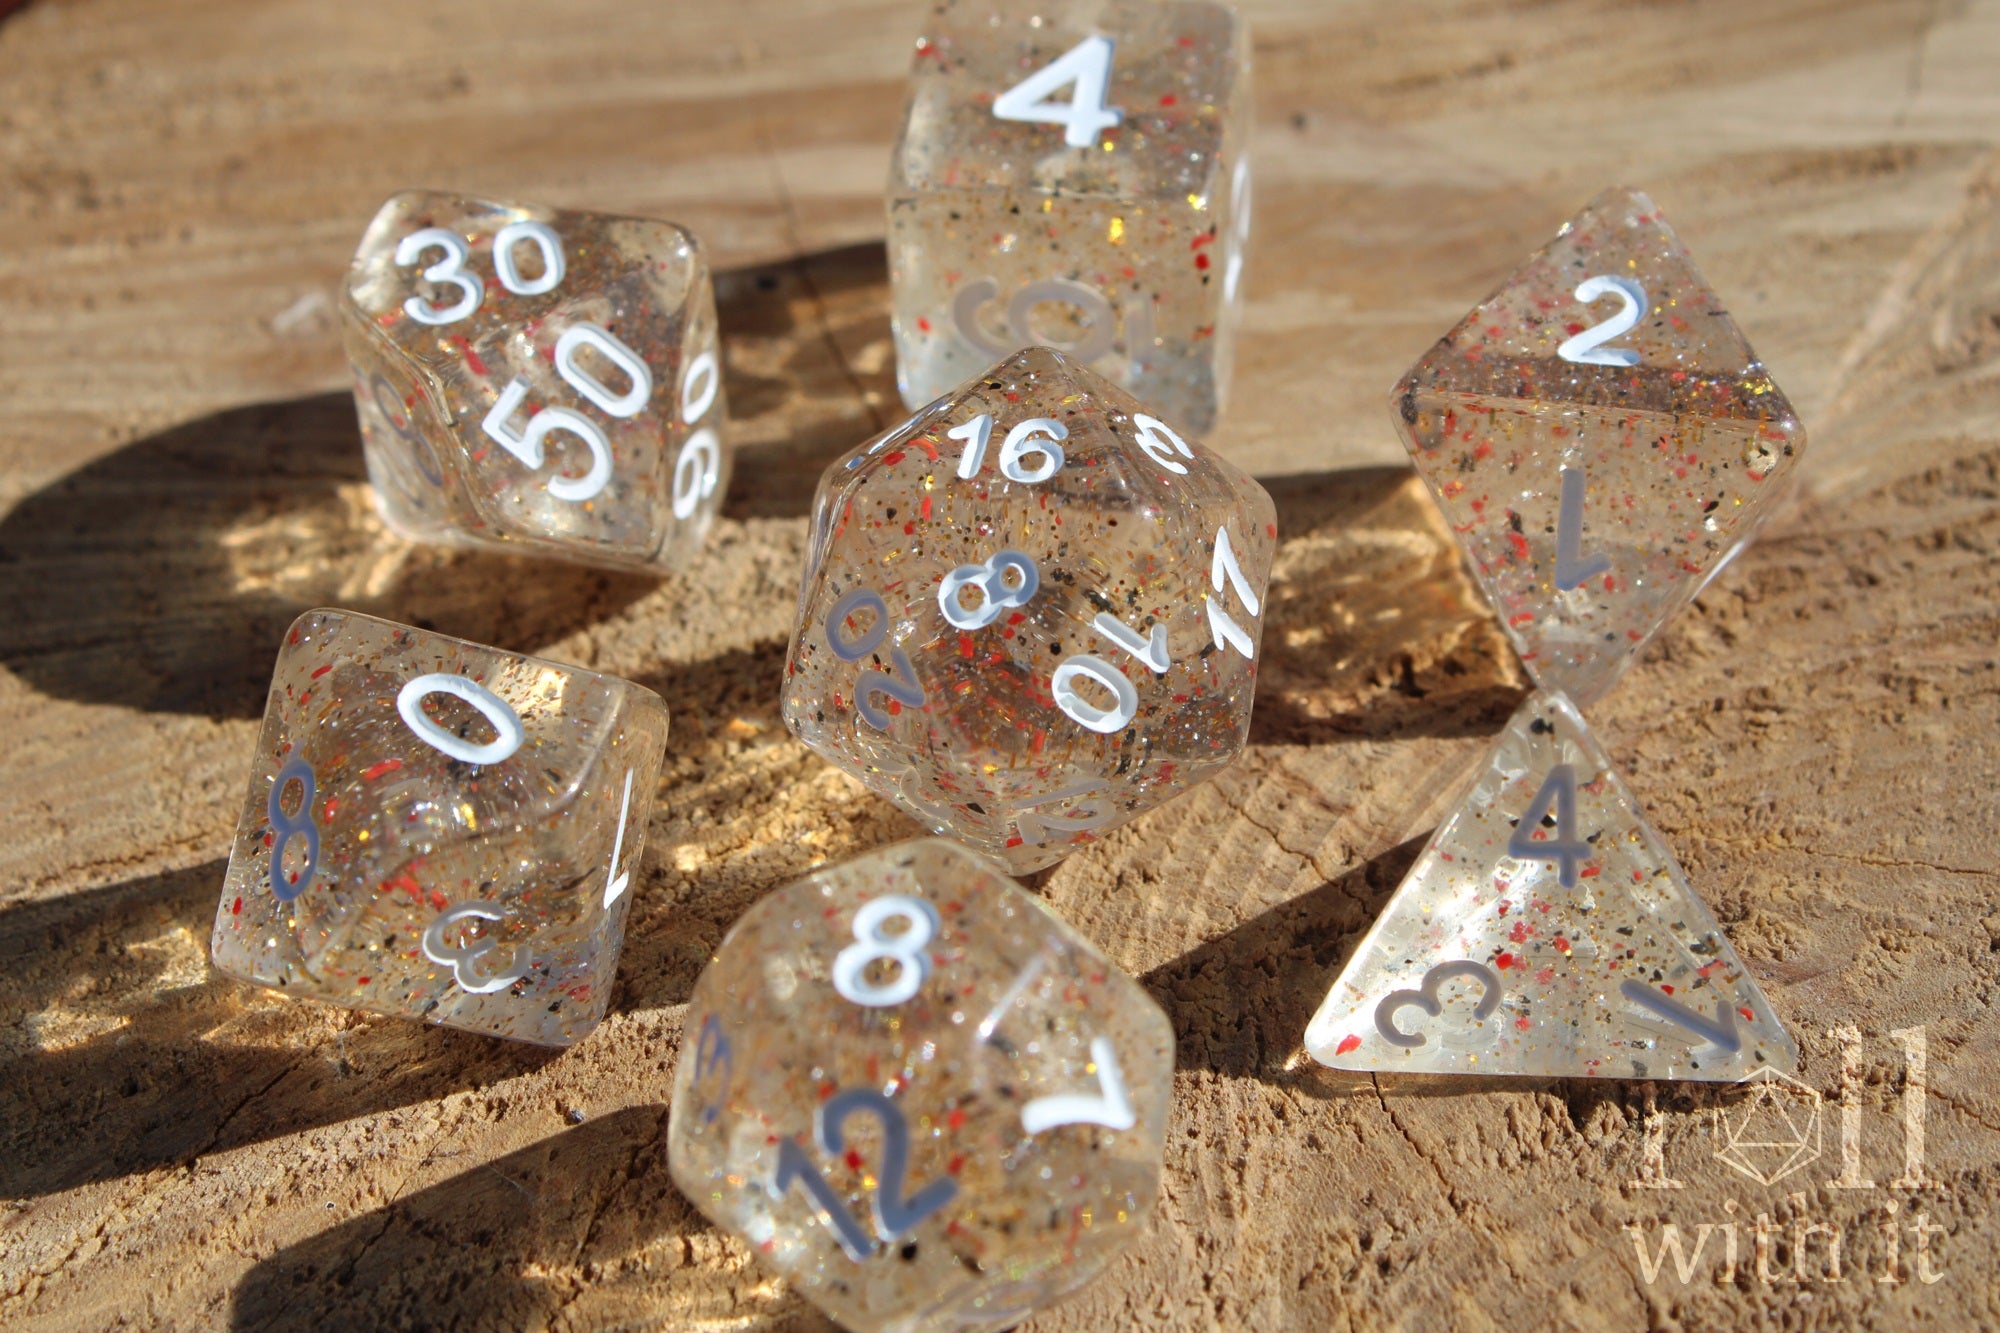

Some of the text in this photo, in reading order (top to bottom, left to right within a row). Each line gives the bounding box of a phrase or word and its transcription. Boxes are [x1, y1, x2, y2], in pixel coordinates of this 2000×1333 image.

[993, 35, 1124, 146] 4
[395, 221, 566, 325] 30
[1557, 275, 1647, 366] 2
[482, 320, 652, 500] 50
[947, 414, 1069, 483] 16
[938, 549, 1040, 630] 8
[825, 587, 925, 731] 20
[1051, 612, 1171, 733] 10
[397, 673, 525, 765] 0
[268, 757, 319, 902] 8
[1507, 764, 1592, 888] 4
[833, 895, 940, 1007] 8
[1374, 960, 1502, 1048] 3
[766, 1087, 960, 1263] 12
